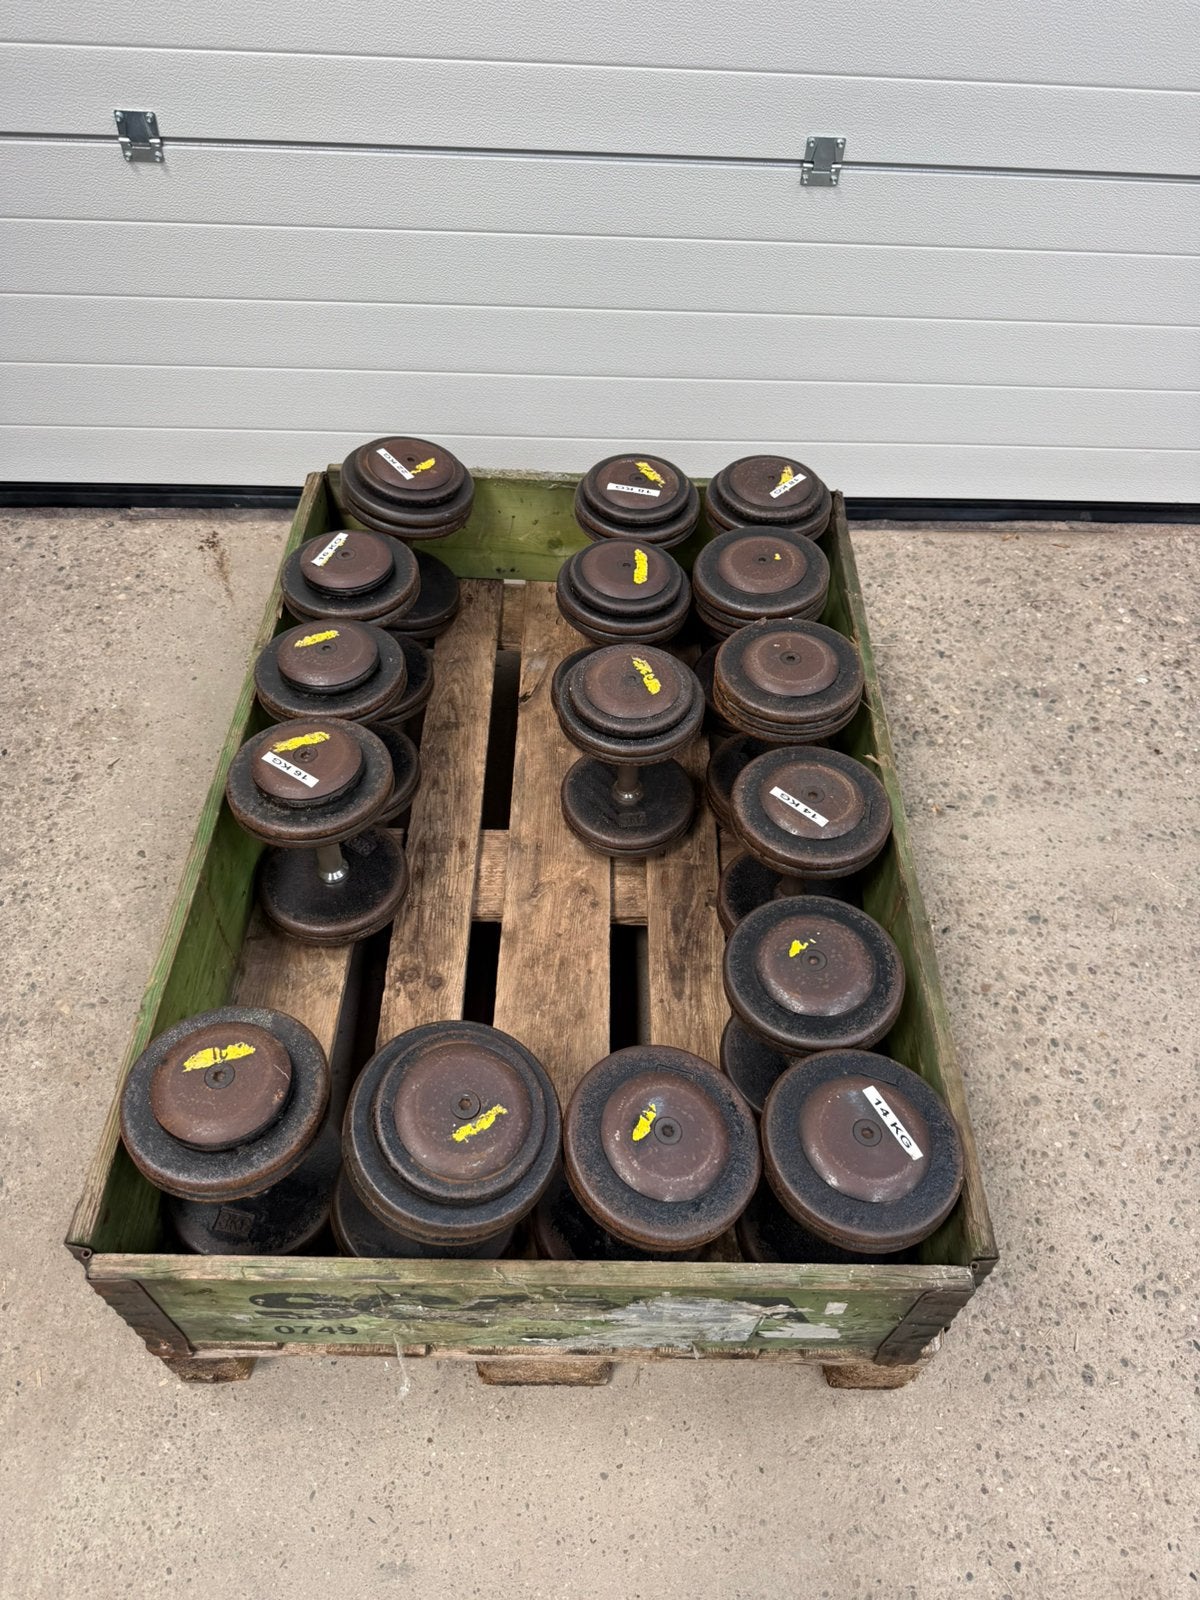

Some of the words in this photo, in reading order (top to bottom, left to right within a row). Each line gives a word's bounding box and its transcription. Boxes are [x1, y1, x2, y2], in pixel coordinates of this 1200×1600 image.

[383, 452, 398, 465] KG
[773, 484, 789, 495] KG
[328, 537, 342, 550] KG
[272, 757, 292, 771] KG
[293, 770, 308, 781] 16
[780, 793, 800, 808] KG
[803, 808, 818, 820] 14
[874, 1097, 890, 1118] 14
[890, 1121, 913, 1149] KG
[273, 1323, 359, 1335] 0749
